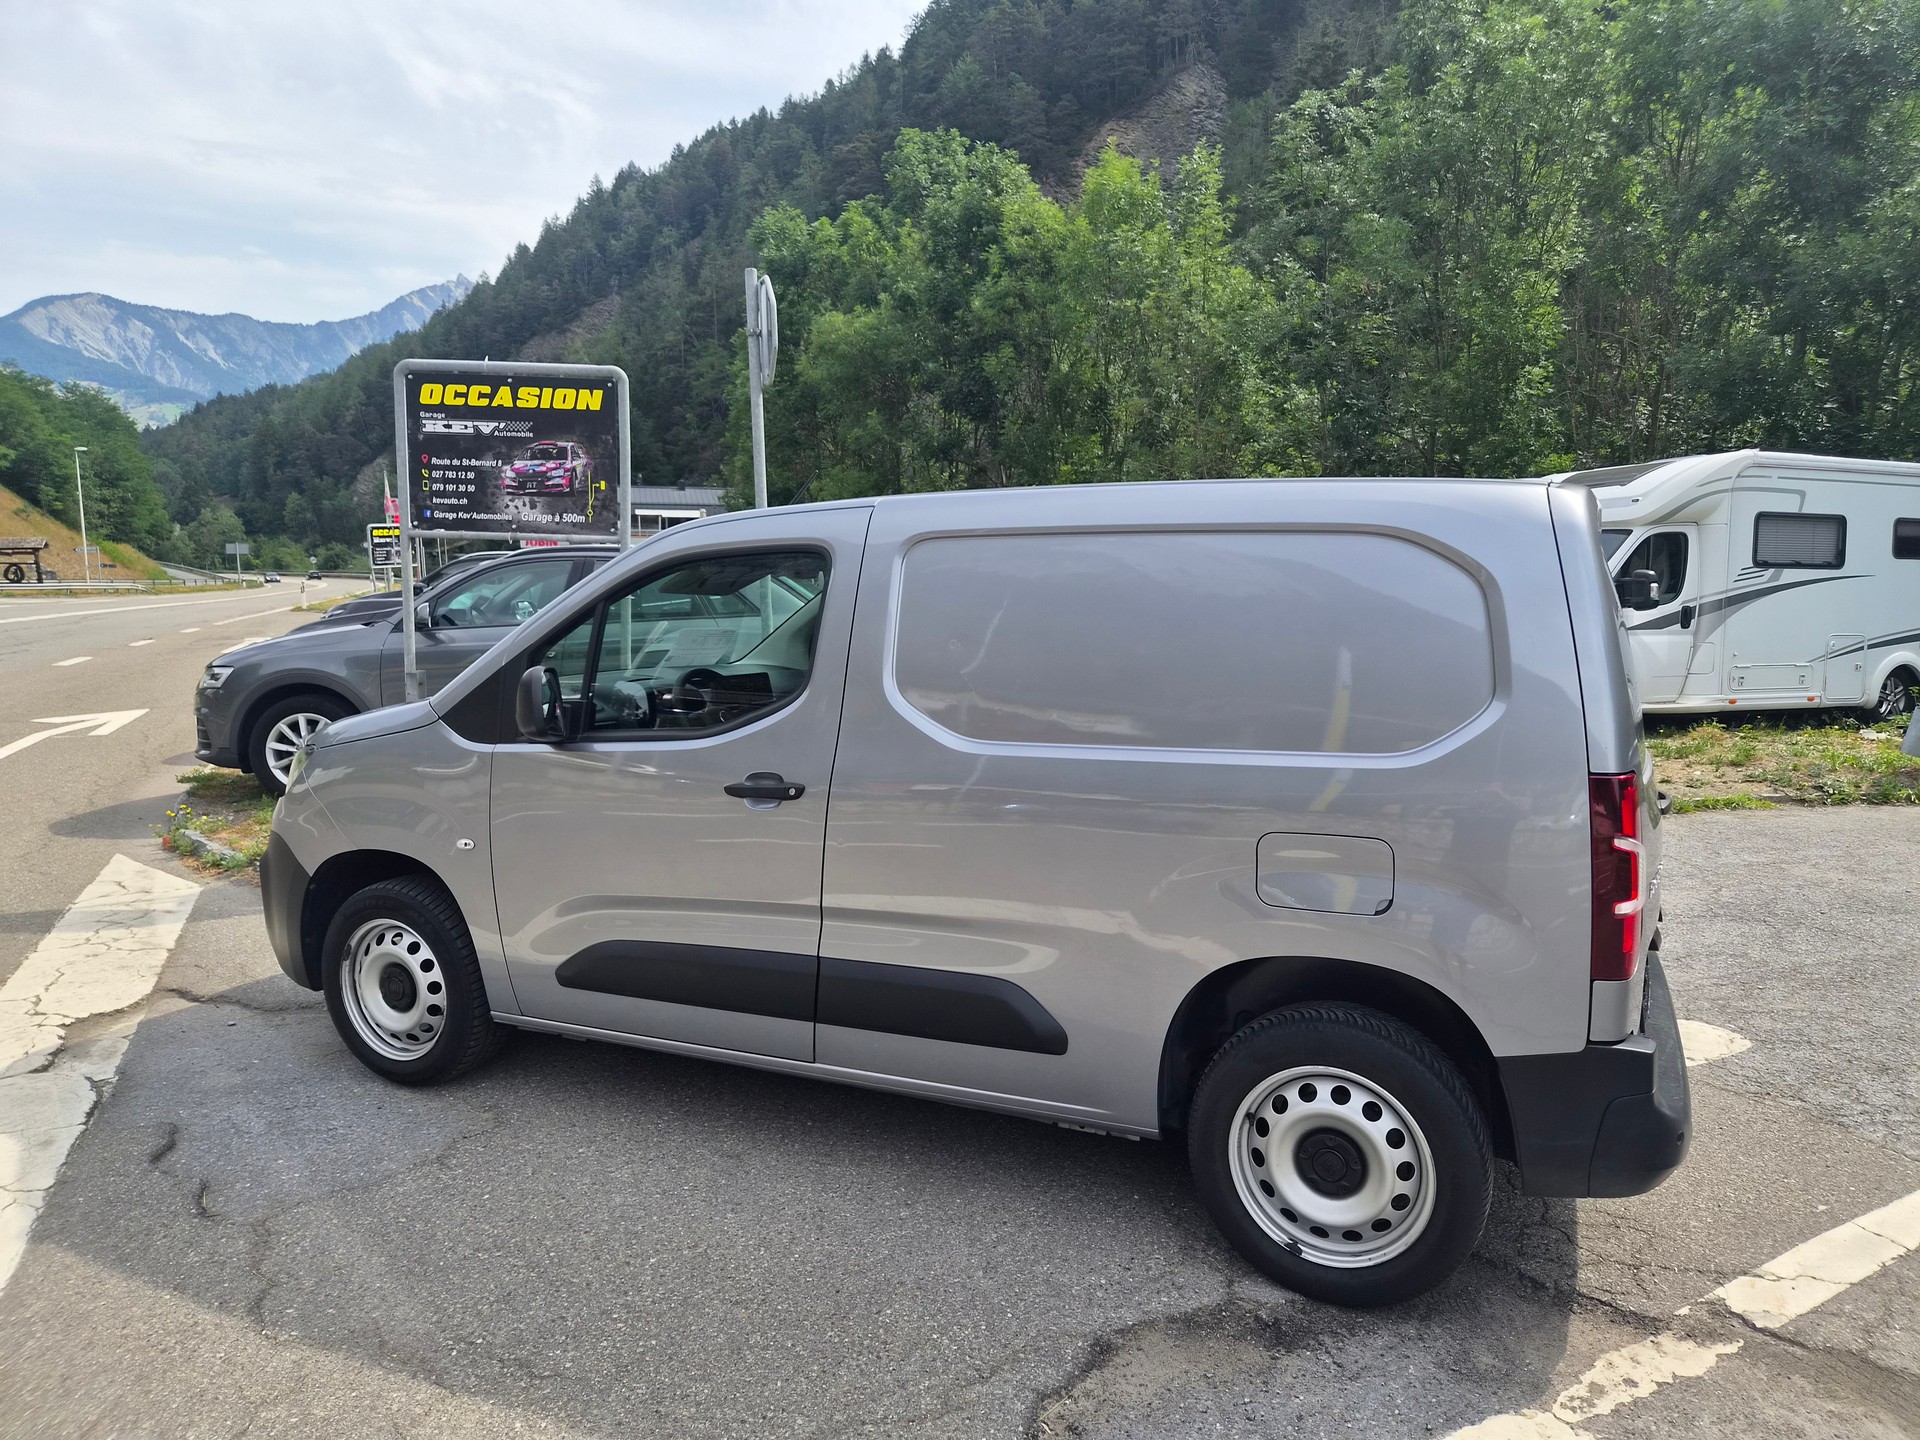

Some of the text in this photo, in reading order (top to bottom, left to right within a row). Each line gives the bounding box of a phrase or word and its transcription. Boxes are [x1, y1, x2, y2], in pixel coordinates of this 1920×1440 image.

[419, 383, 604, 411] OCCASION
[419, 411, 446, 419] Garage
[431, 457, 502, 467] Route du St-Bernard 8
[431, 470, 475, 479] 027 783 12 50
[431, 483, 444, 491] 079
[445, 484, 456, 492] 101
[457, 484, 466, 492] 30
[432, 496, 468, 505] kevauto.ch
[433, 510, 513, 521] Garage Kev'Automobiles
[521, 512, 586, 523] Garage à 500m
